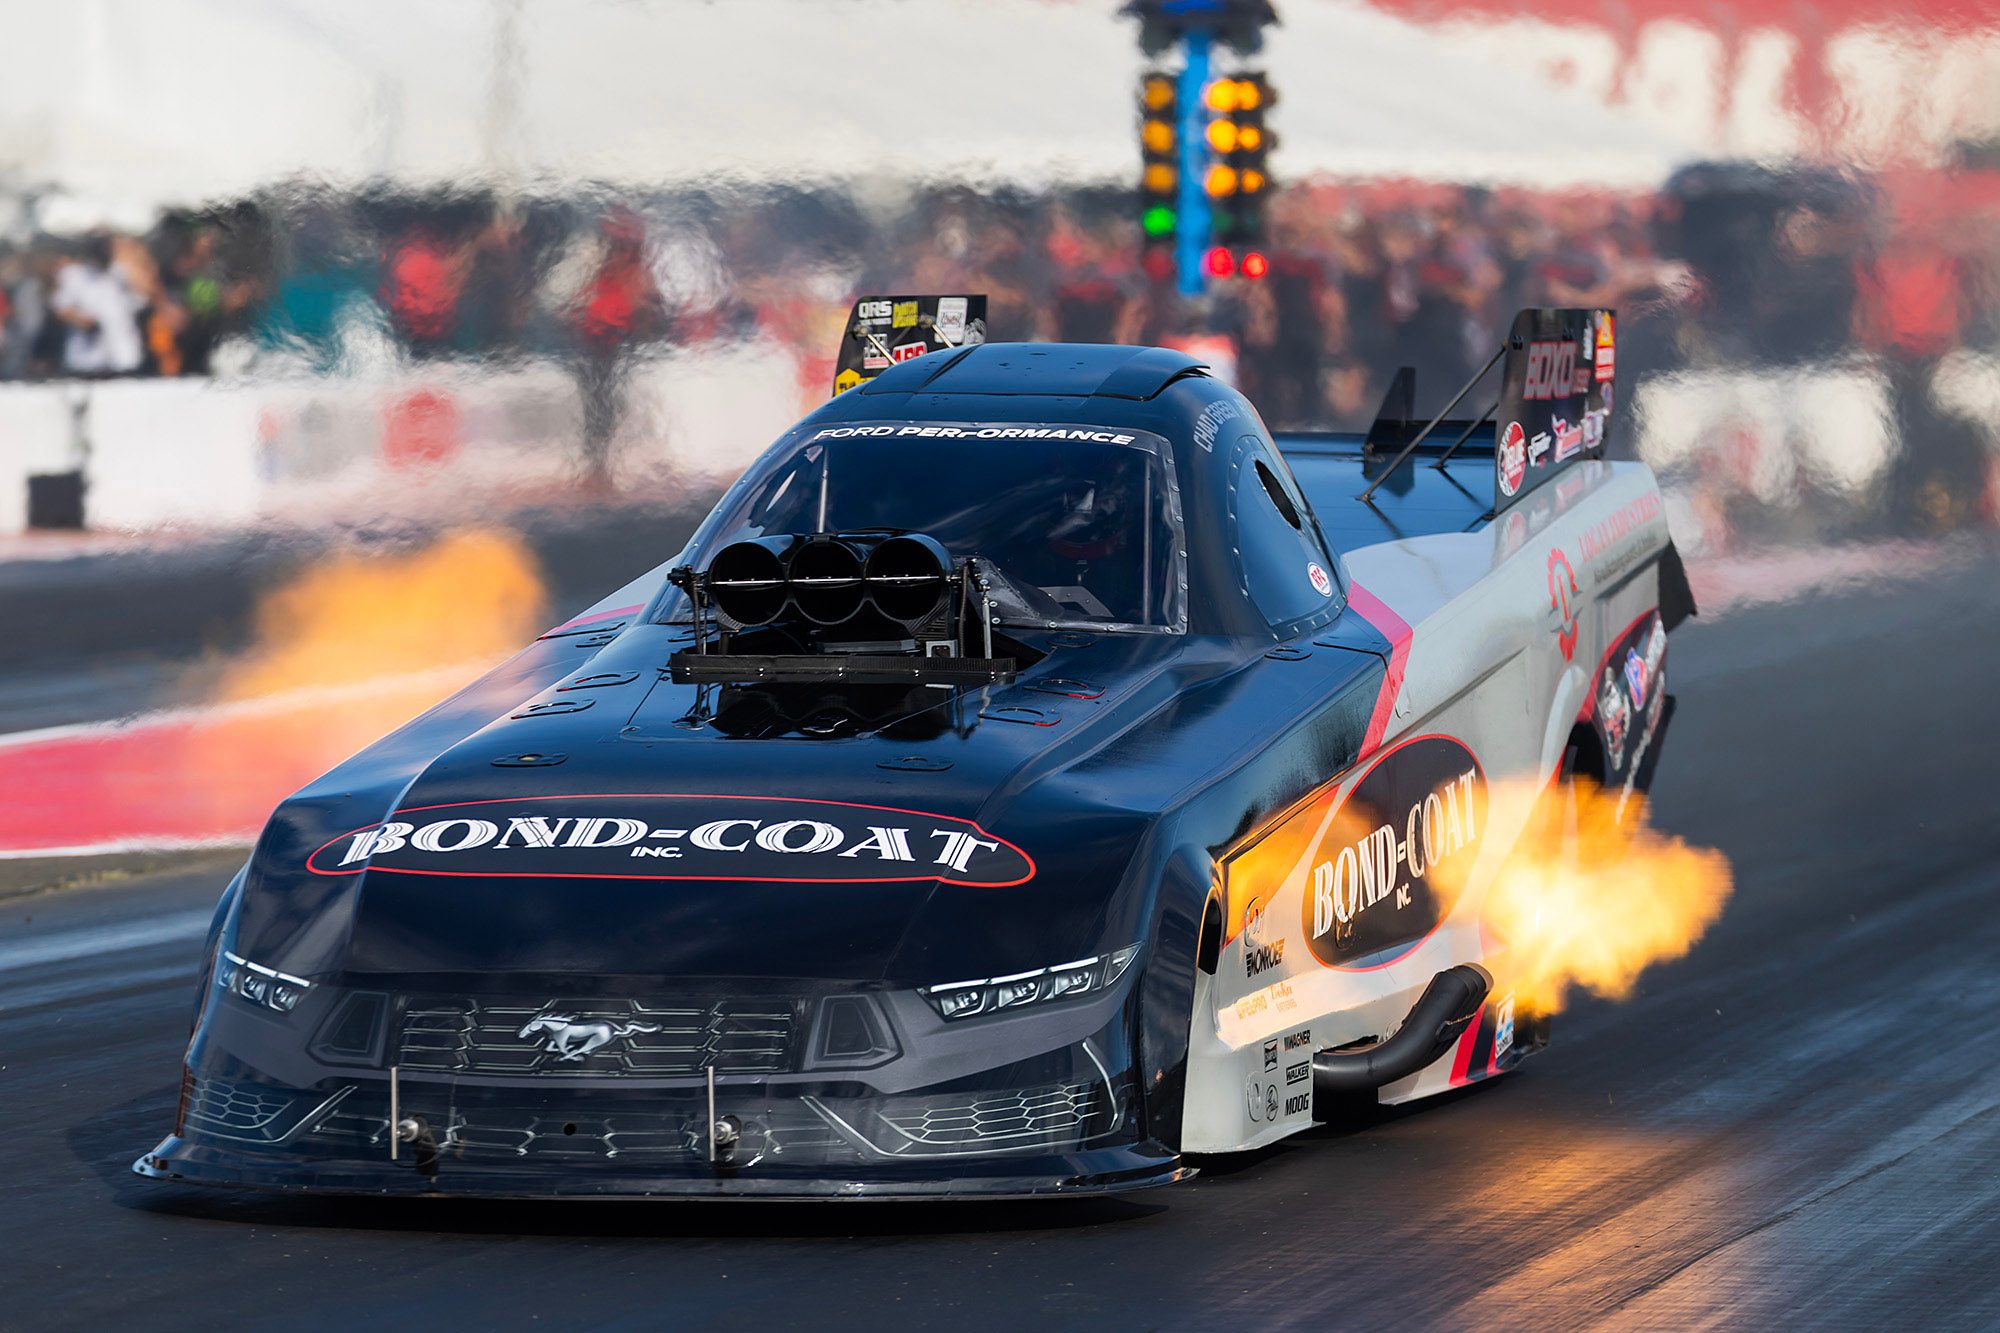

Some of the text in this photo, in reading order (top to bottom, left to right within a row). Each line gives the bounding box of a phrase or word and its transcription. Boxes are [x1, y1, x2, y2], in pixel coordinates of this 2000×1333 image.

[813, 426, 1135, 445] FORD PERFORMANCE
[1193, 413, 1219, 453] CHAD
[337, 816, 999, 873] BOND-COAT
[1313, 765, 1477, 940] BOND-COAT
[1247, 939, 1285, 977] MONROE
[1284, 1030, 1311, 1051] WAGNER
[1287, 1065, 1310, 1081] WALKER
[1285, 1092, 1310, 1116] MOOG
